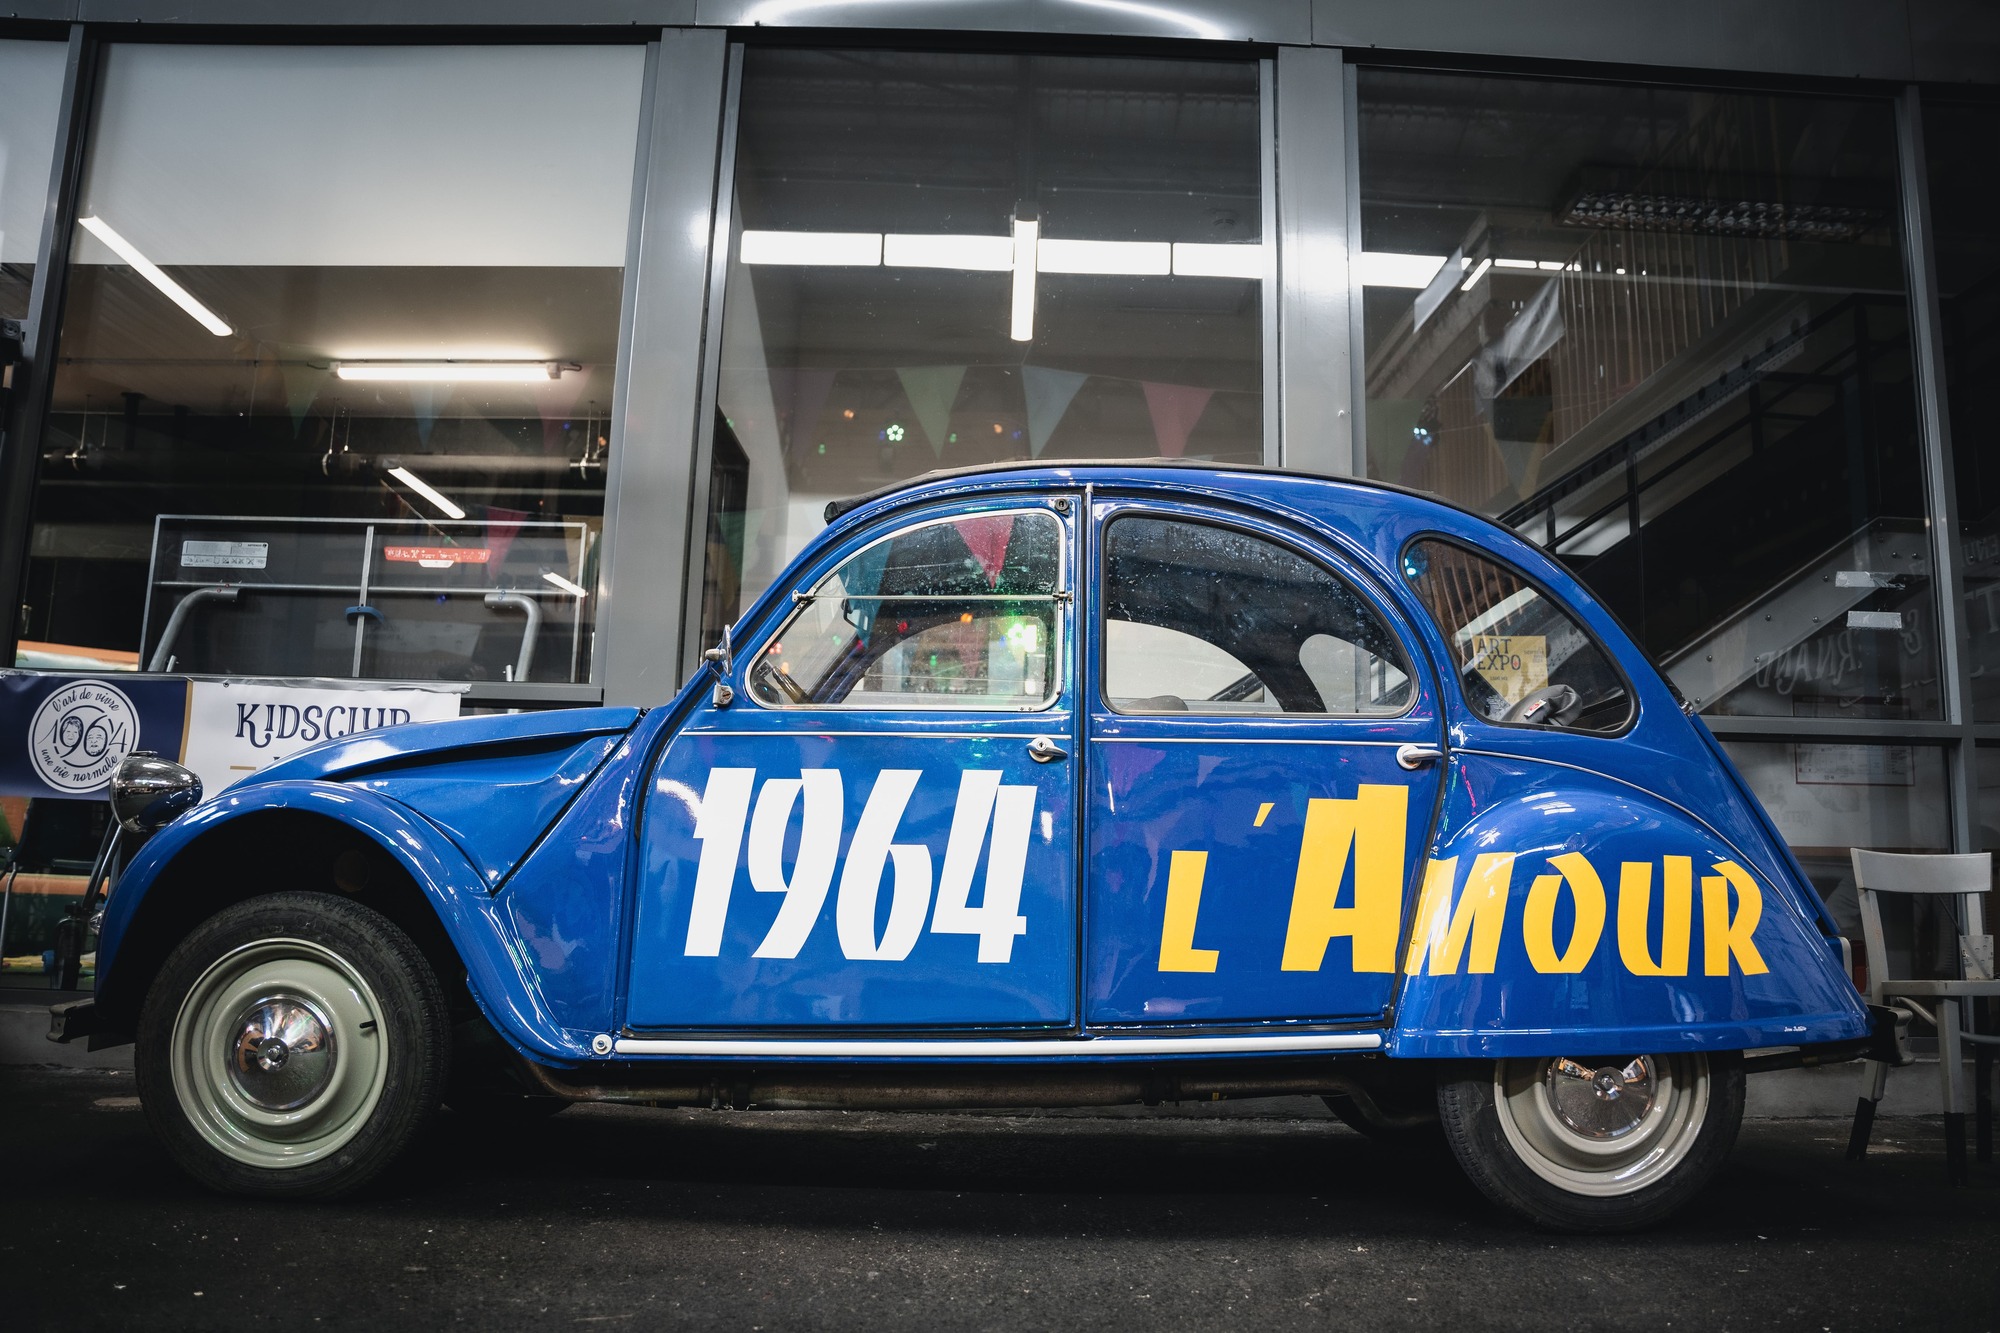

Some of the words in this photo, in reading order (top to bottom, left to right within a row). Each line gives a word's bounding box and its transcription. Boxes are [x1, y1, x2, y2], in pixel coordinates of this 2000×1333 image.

[1476, 638, 1512, 657] ART
[1476, 654, 1522, 671] EXPO
[79, 687, 93, 700] de
[95, 692, 119, 712] vivre
[37, 714, 128, 758] 1964
[41, 748, 54, 767] une
[53, 766, 70, 779] vie
[72, 755, 118, 782] normale
[684, 767, 1039, 964] 1964
